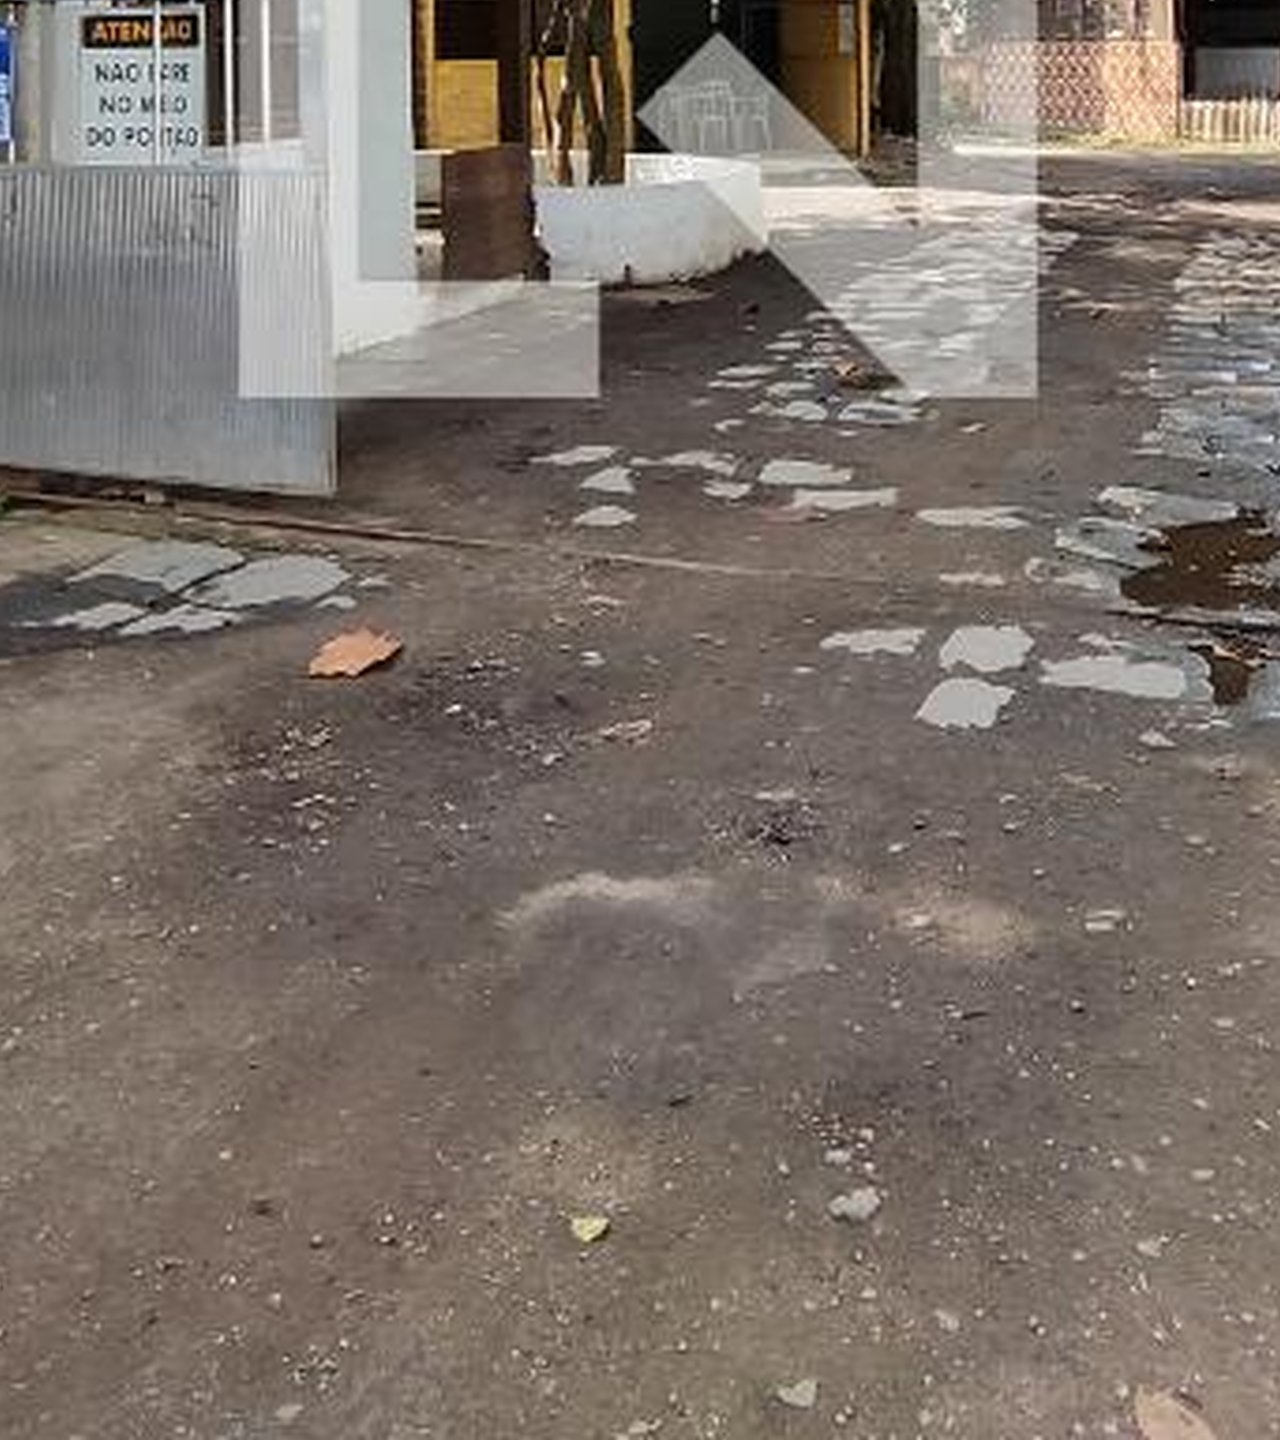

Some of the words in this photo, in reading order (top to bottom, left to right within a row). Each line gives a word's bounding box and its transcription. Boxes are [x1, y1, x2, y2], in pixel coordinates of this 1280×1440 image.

[92, 19, 192, 43] ATENÃO
[99, 95, 132, 115] NO
[86, 126, 116, 148] DO
